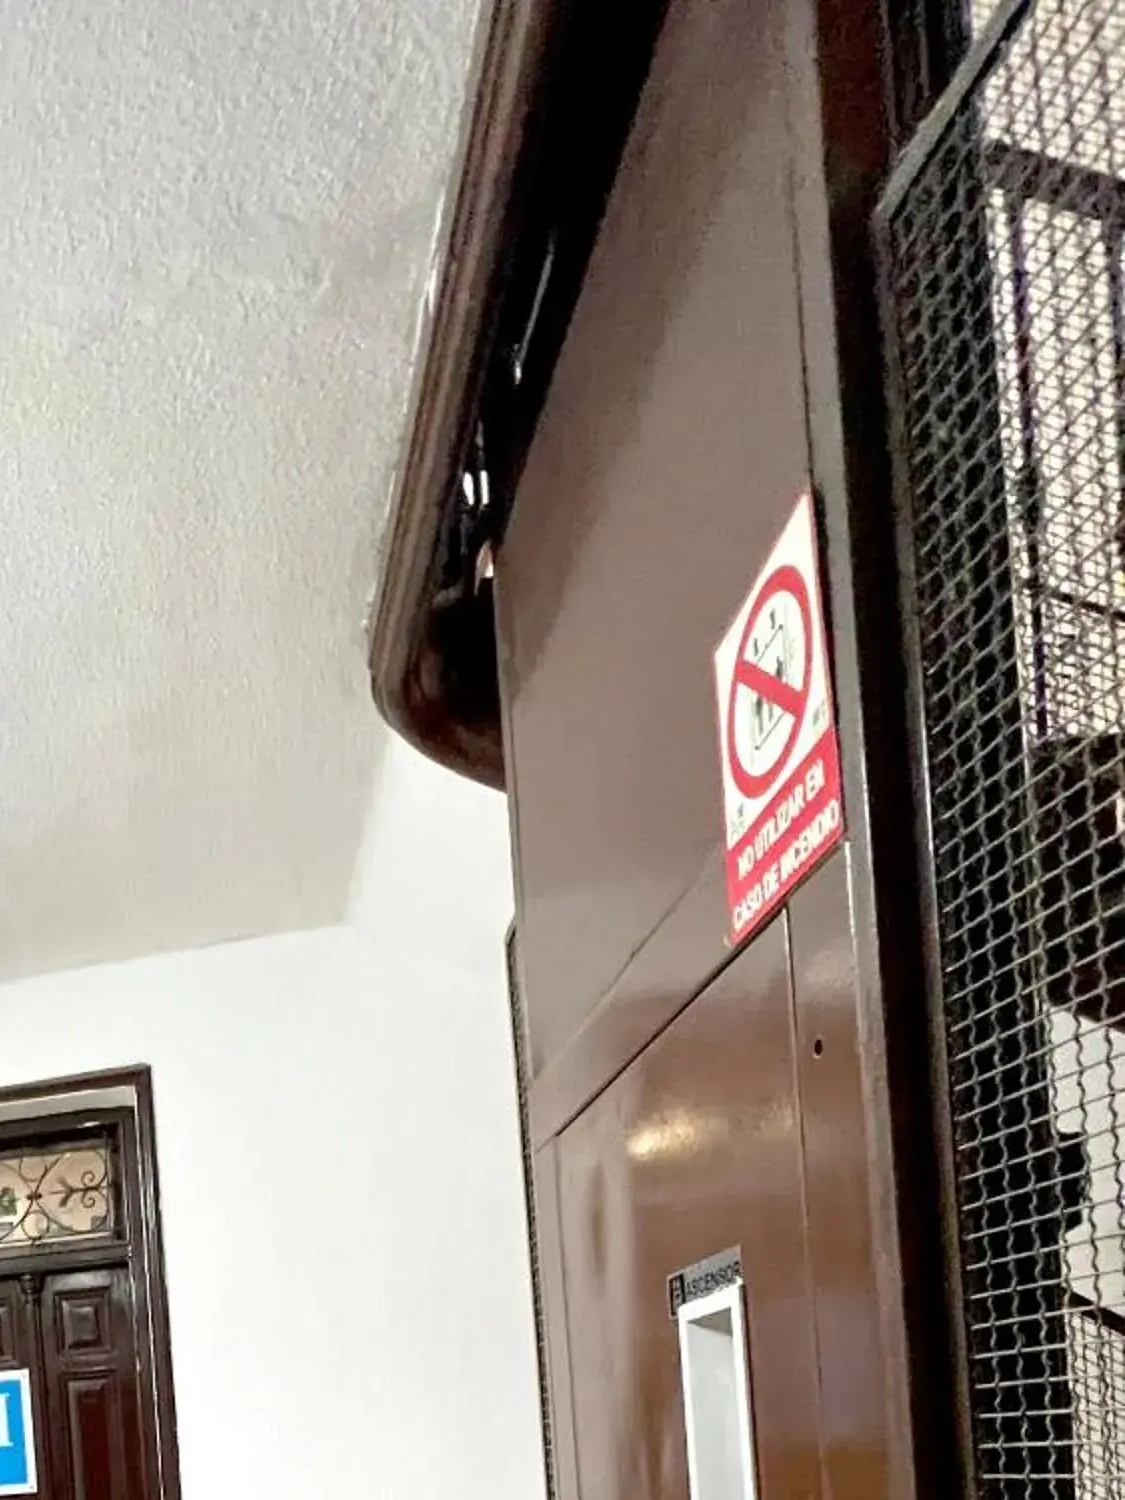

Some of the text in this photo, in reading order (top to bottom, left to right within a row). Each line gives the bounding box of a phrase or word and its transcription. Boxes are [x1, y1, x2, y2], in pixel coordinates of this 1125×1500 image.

[733, 800, 839, 932] CASO DE INCENDIO
[737, 844, 755, 880] NO
[755, 783, 805, 861] UTILIZAR
[806, 759, 824, 801] EN
